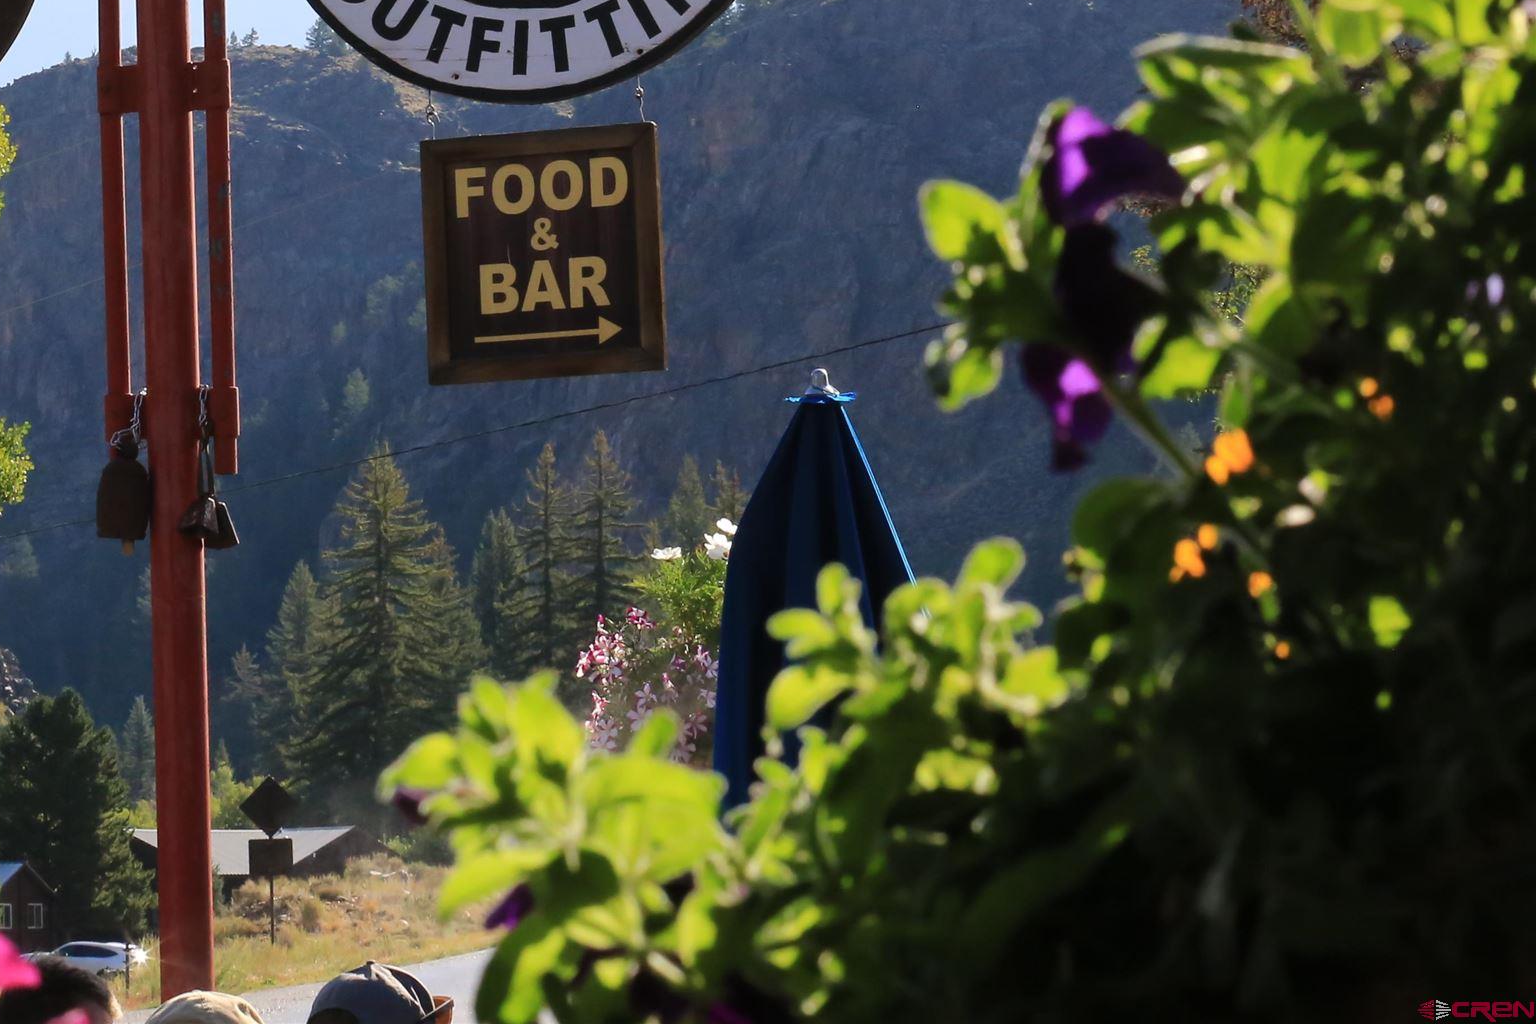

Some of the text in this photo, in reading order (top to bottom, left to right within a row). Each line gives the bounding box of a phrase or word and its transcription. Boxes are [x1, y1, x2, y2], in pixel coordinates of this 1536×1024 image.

[454, 156, 629, 219] FOOD
[530, 217, 560, 252] &
[479, 255, 612, 316] BAR
